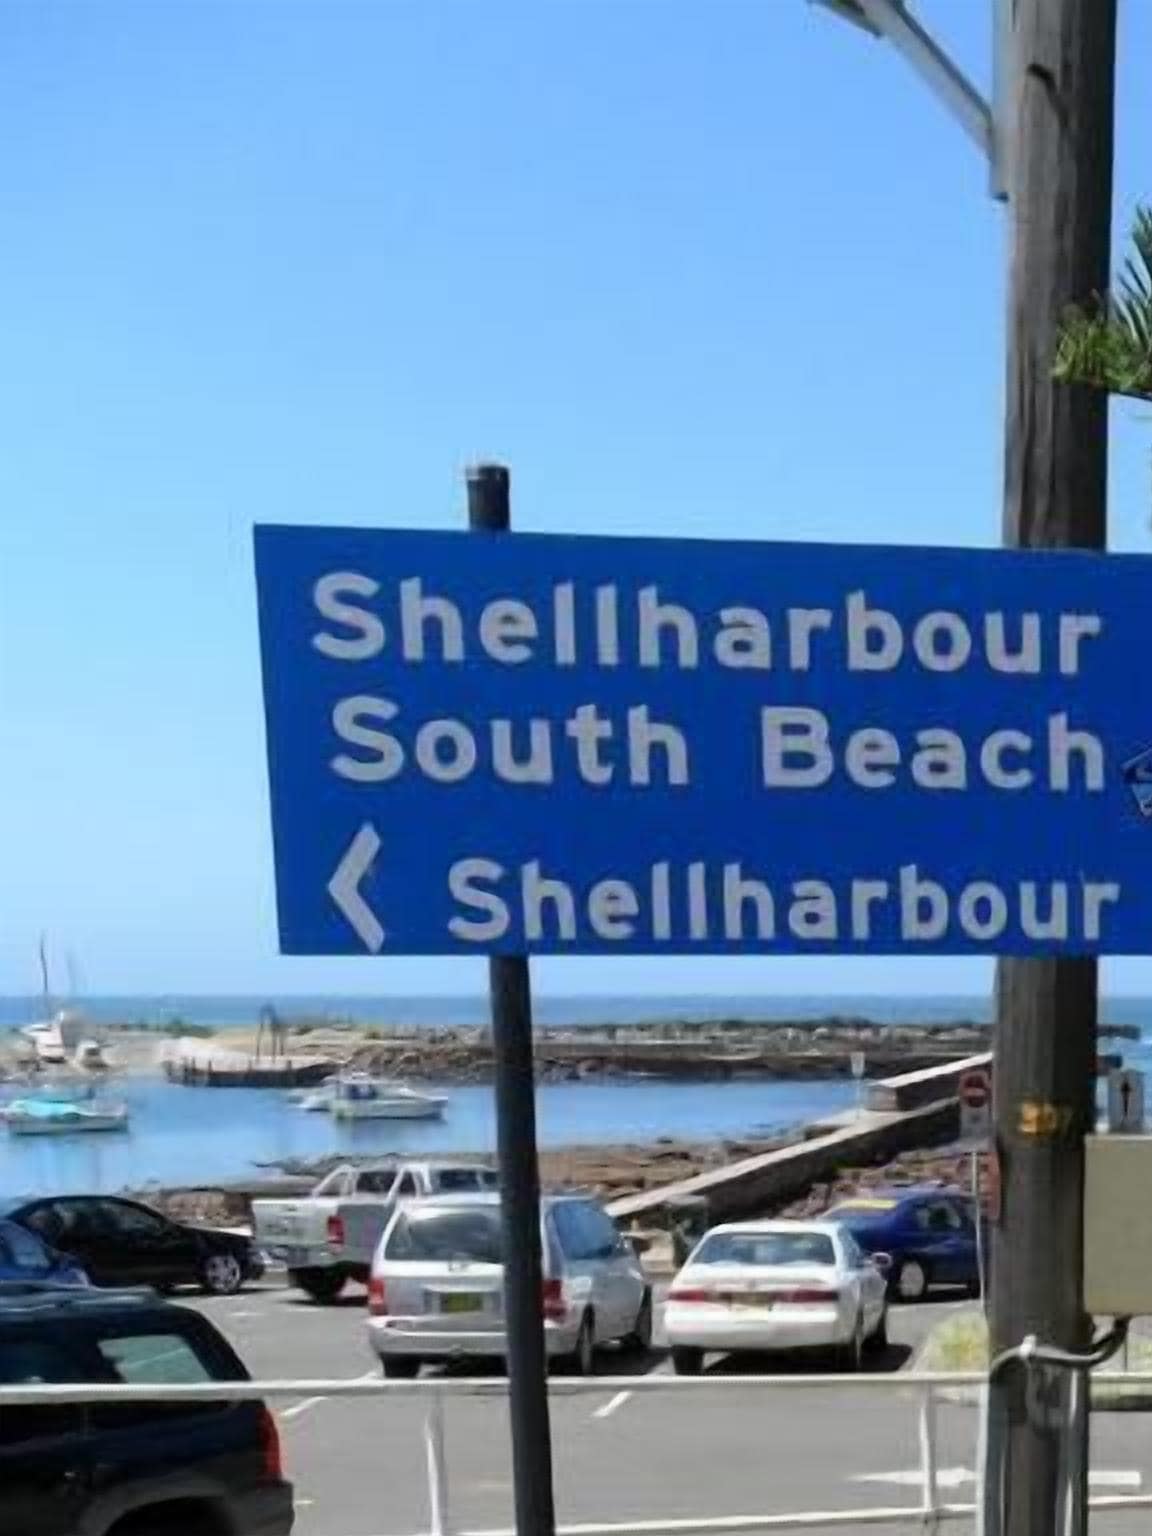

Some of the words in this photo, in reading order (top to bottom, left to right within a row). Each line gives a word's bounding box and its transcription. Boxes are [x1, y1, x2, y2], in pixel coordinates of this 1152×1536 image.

[312, 571, 1101, 675] Shellharbour
[331, 694, 689, 786] South
[761, 705, 1104, 792] Beach
[447, 857, 1119, 942] Shellharbour
